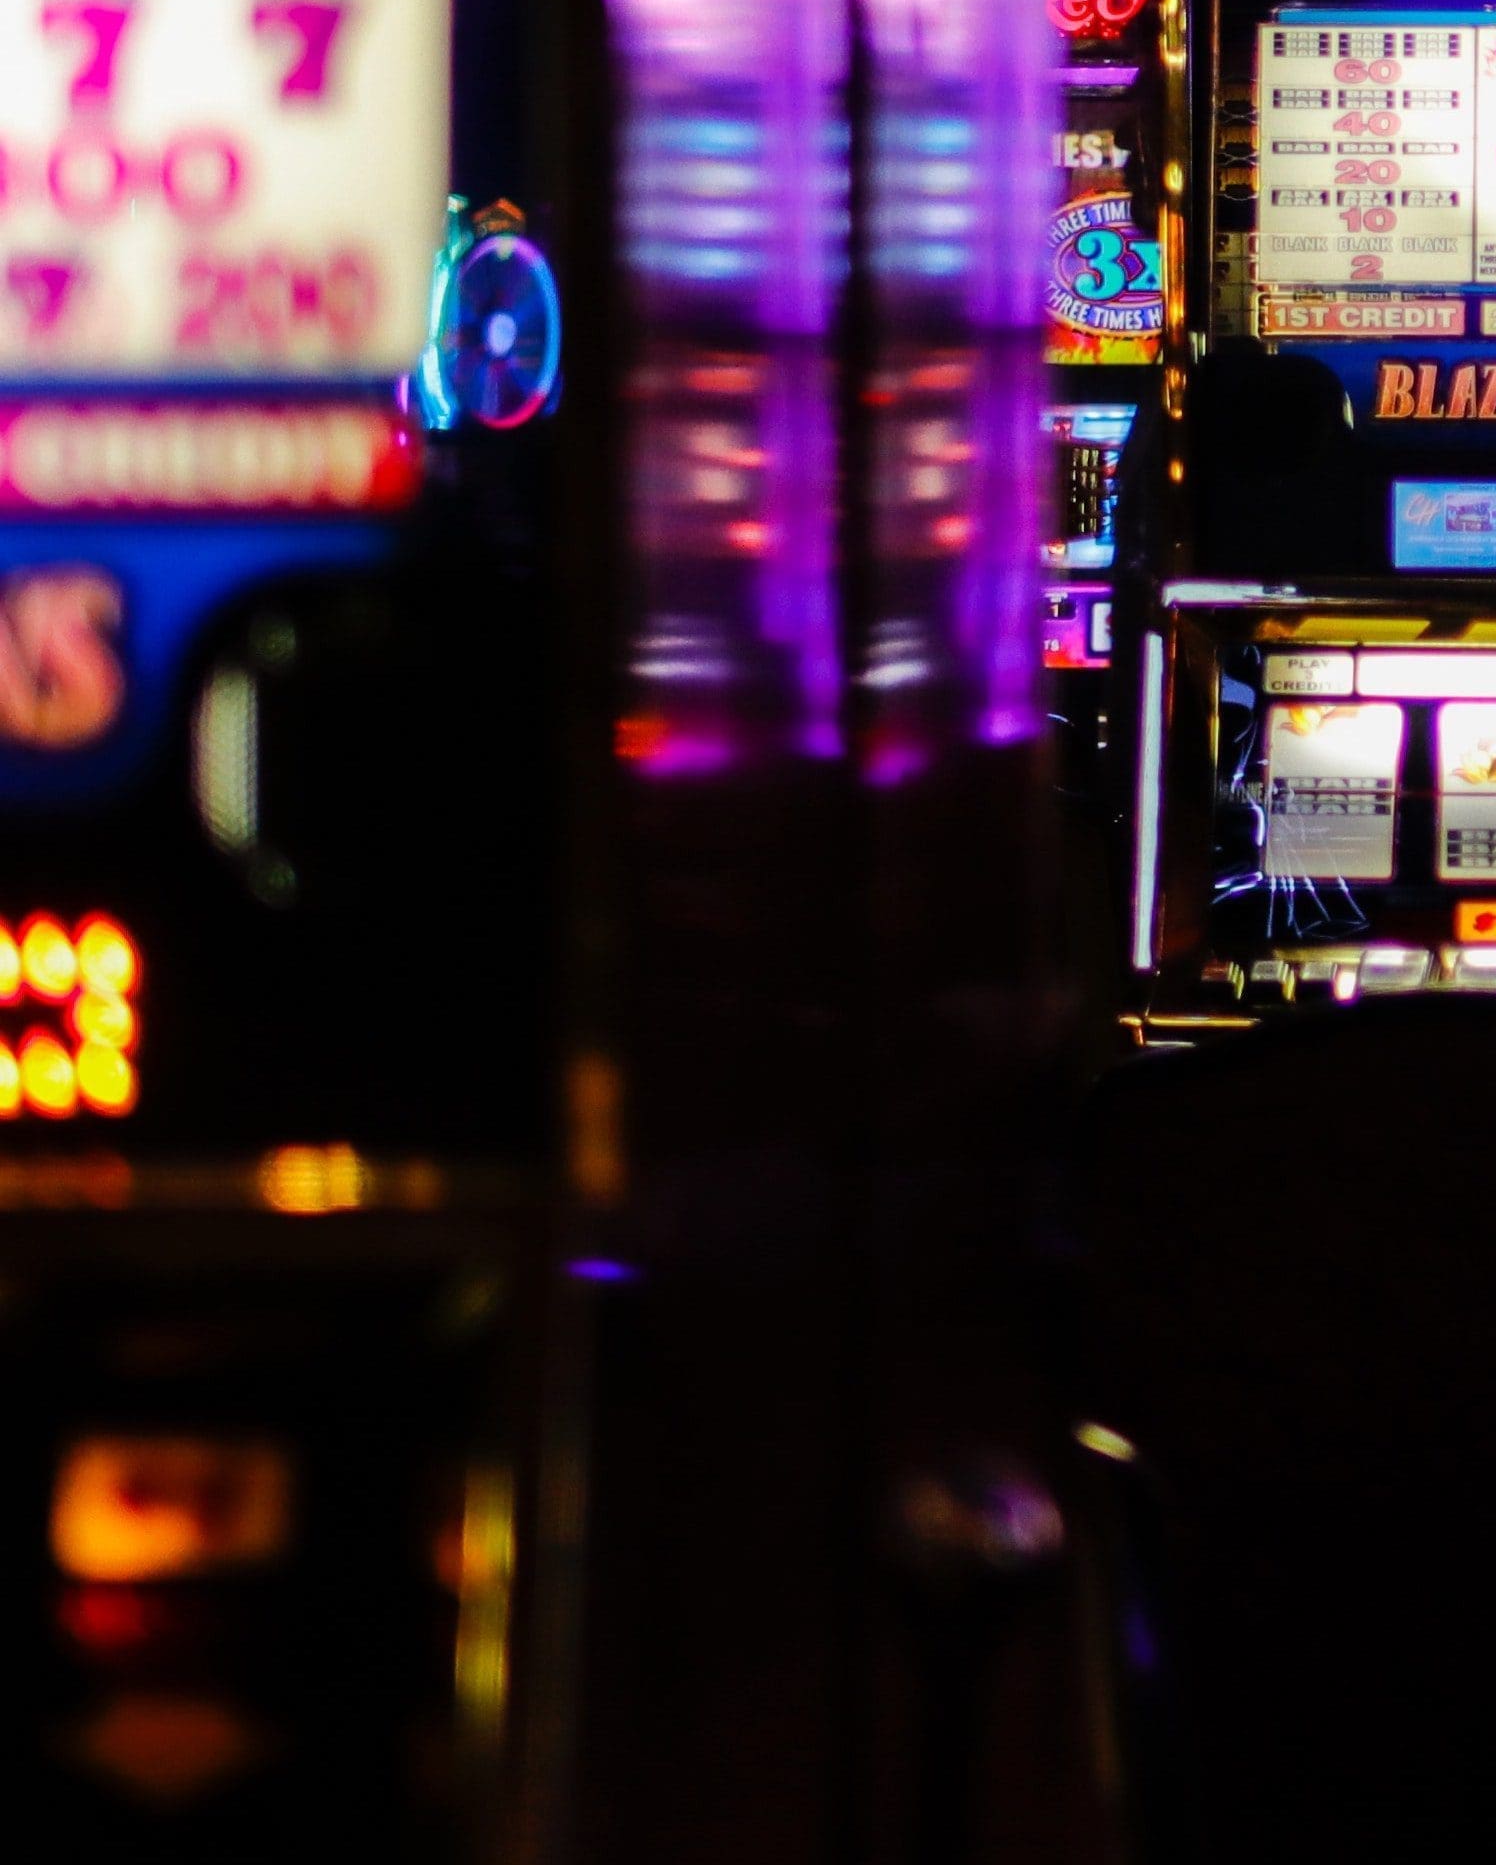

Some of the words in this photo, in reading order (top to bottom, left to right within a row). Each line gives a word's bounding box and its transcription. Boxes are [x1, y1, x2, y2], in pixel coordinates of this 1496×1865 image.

[1333, 58, 1402, 85] 60
[1332, 110, 1402, 137] 40
[1333, 159, 1402, 185] 20
[1339, 206, 1398, 233] 10
[1272, 236, 1329, 252] BLANK
[1336, 236, 1394, 253] BLANK
[1401, 236, 1459, 253] BLANK
[1350, 253, 1385, 281] 2
[1093, 308, 1144, 330] TIMES
[1274, 306, 1330, 329] 1ST
[1338, 306, 1457, 330] CREDIT
